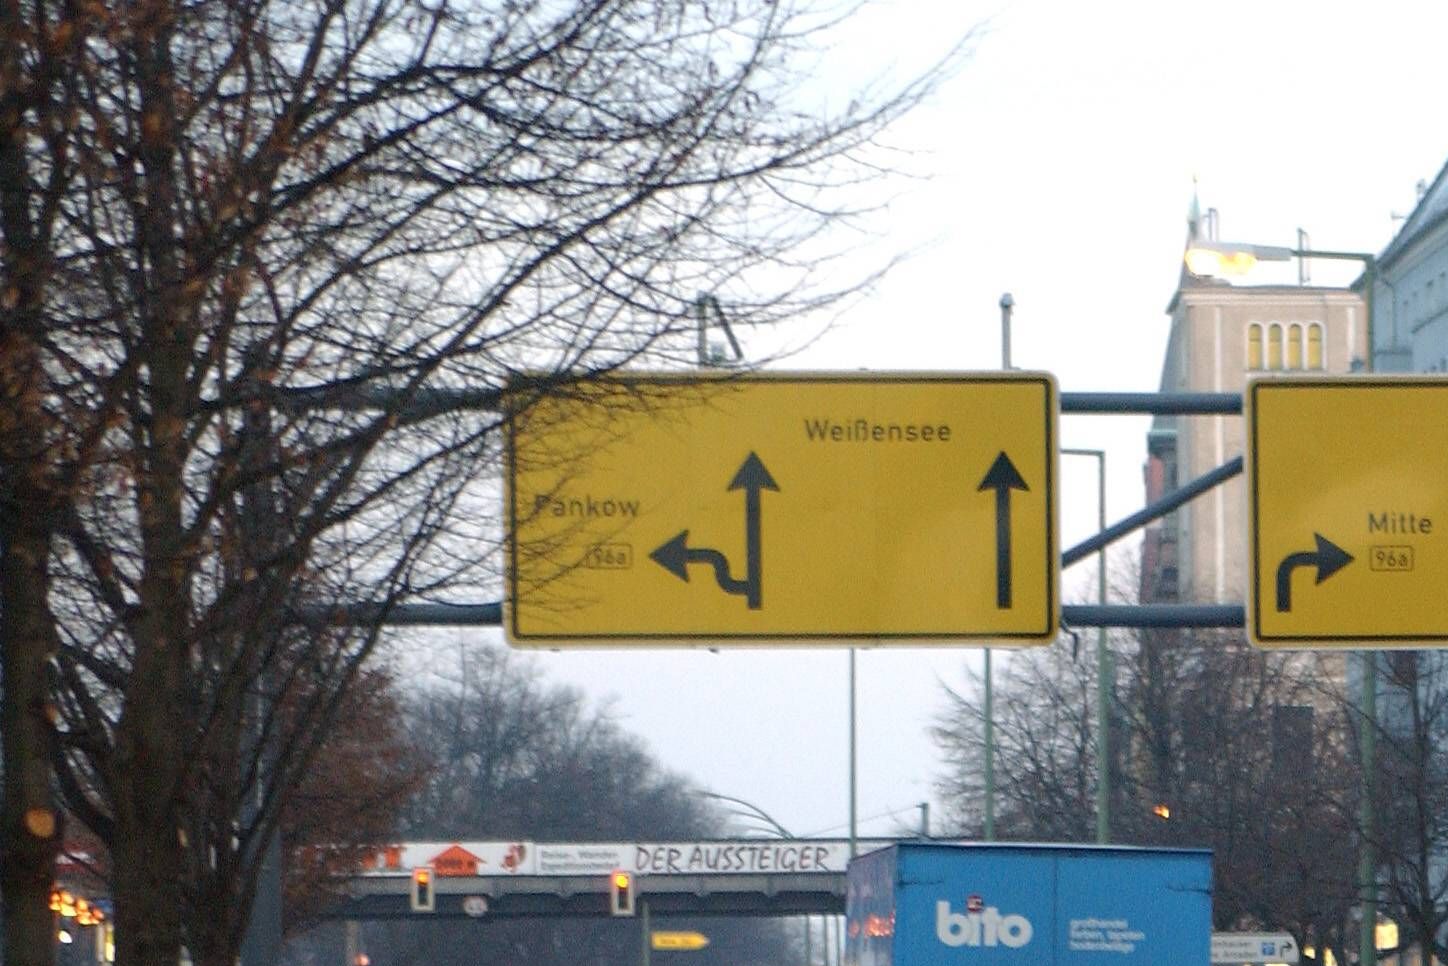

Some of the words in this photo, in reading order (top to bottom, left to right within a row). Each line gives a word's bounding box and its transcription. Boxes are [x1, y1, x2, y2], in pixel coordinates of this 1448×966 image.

[804, 419, 952, 442] Weißensee
[1368, 511, 1433, 534] Mitte
[1376, 551, 1408, 567] 96a
[634, 846, 682, 873] DER
[688, 846, 832, 873] AUSSTEIGER
[936, 893, 1034, 948] bito
